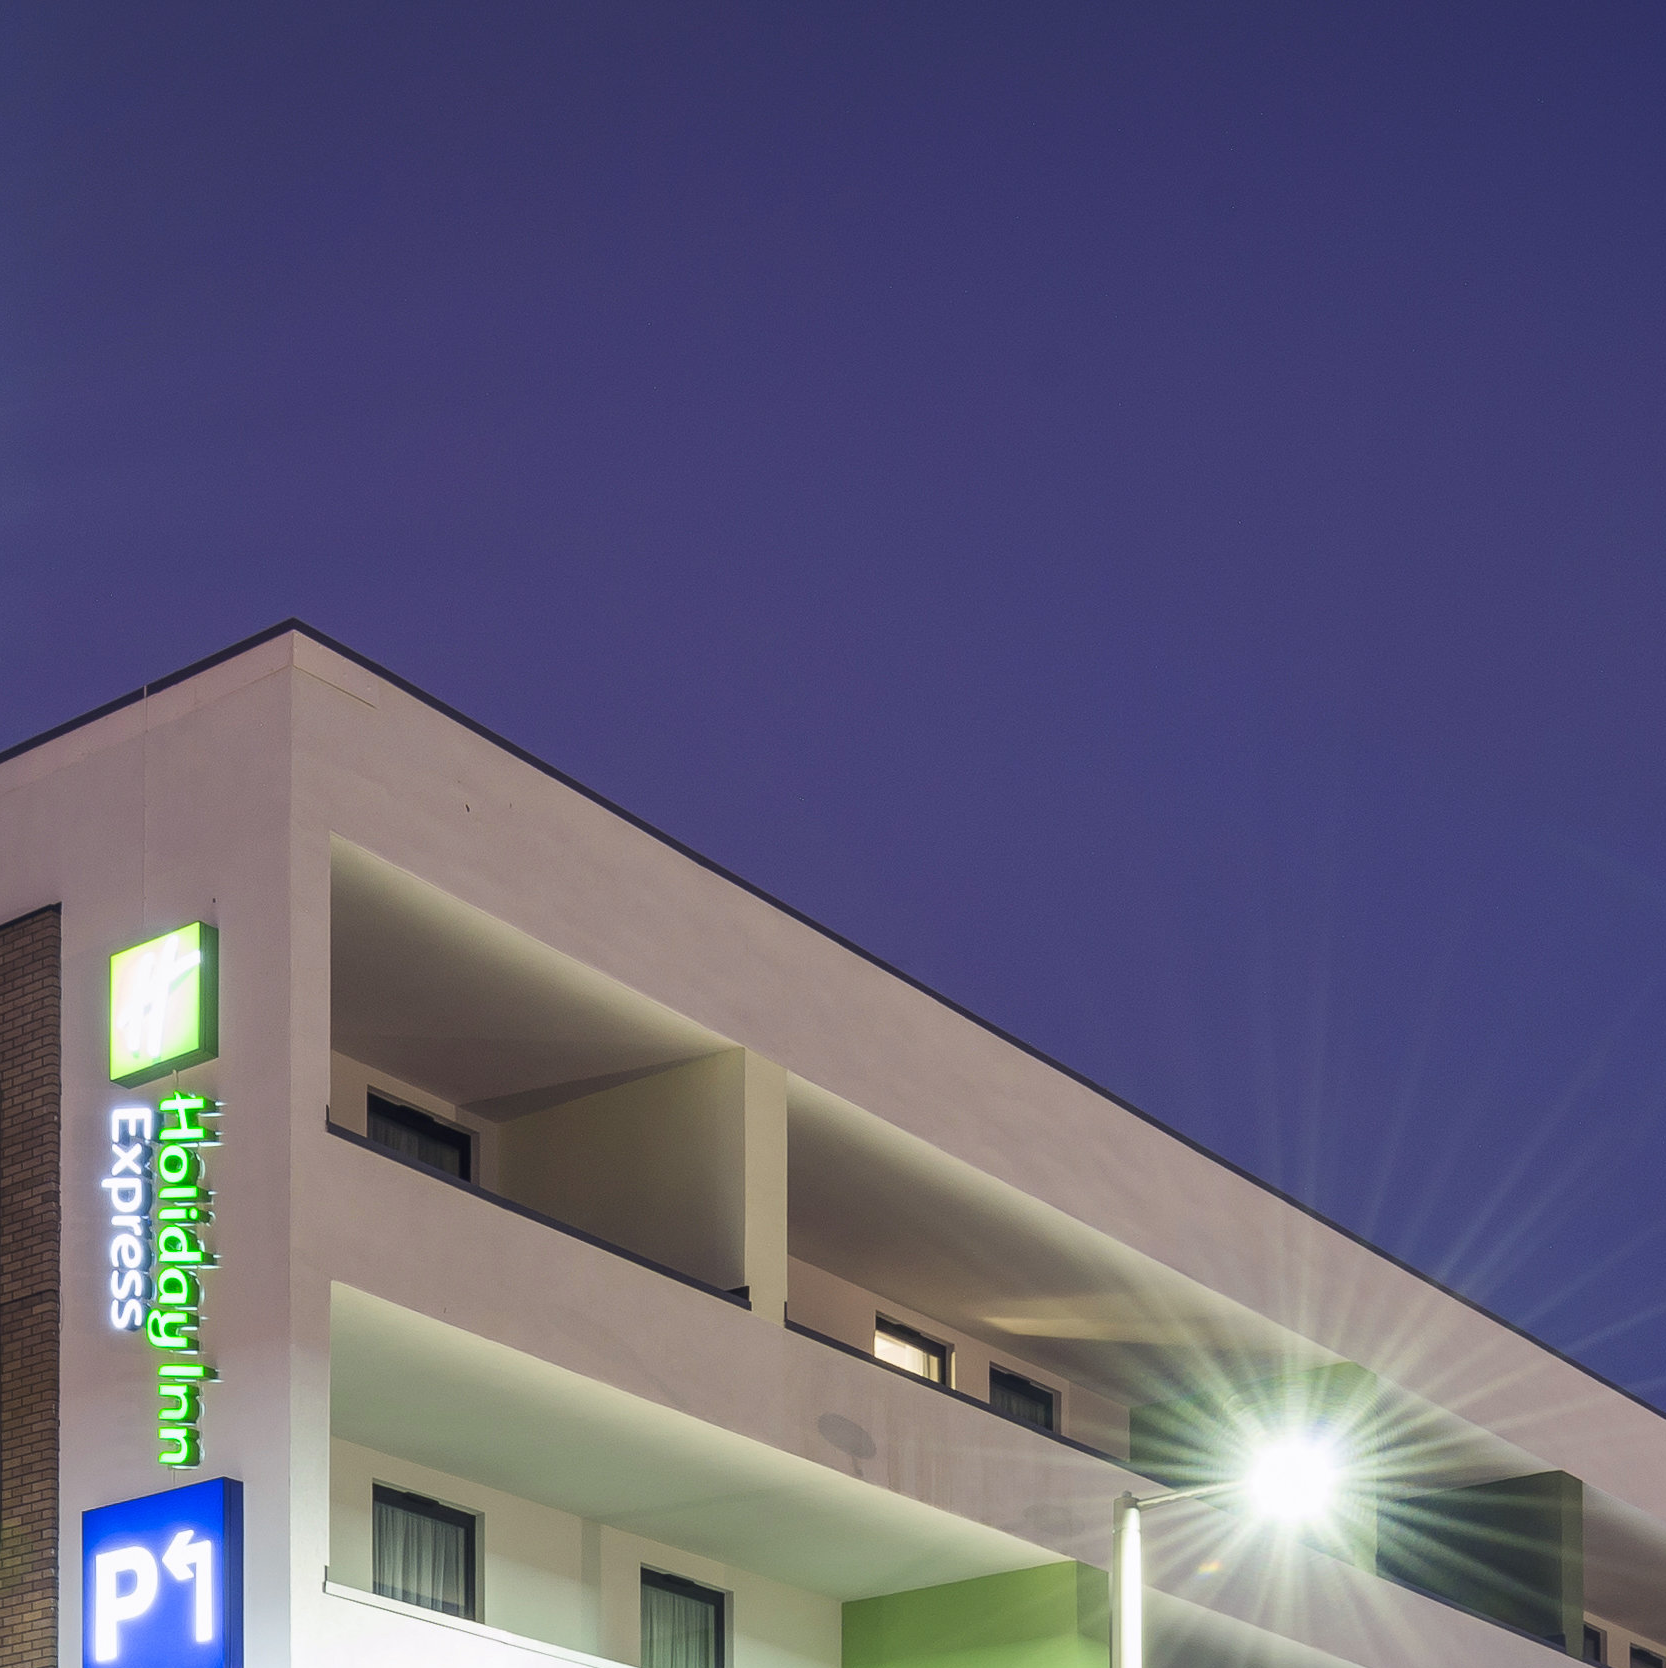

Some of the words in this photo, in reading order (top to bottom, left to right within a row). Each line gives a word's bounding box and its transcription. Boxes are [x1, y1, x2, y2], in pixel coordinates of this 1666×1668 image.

[101, 1106, 154, 1331] Express
[146, 1091, 205, 1348] Holiday
[158, 1364, 204, 1465] Inn
[92, 1544, 160, 1664] P
